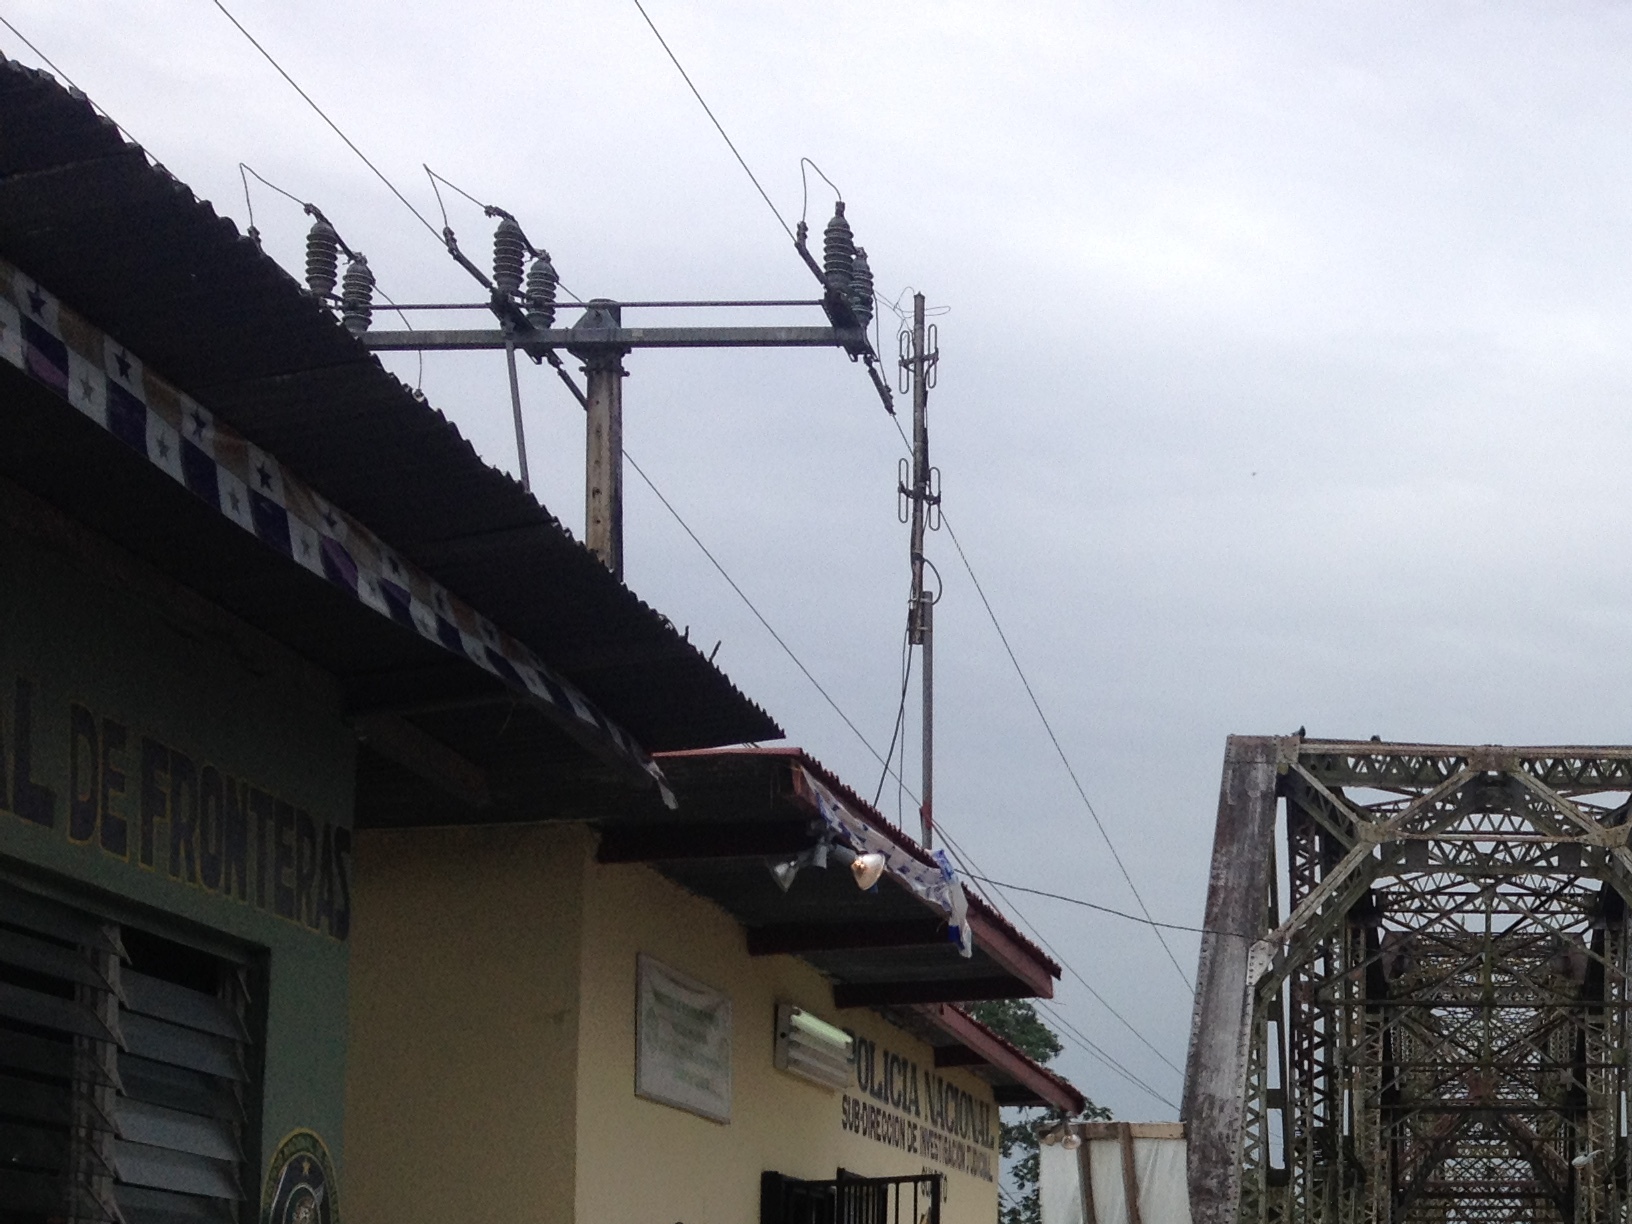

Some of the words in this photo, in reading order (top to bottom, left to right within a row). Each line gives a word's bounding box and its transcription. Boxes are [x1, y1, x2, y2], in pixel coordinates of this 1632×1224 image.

[68, 701, 129, 862] DE
[139, 735, 351, 942] FRONTERAS
[906, 1120, 918, 1155] DE
[924, 1070, 994, 1150] NACIONAL
